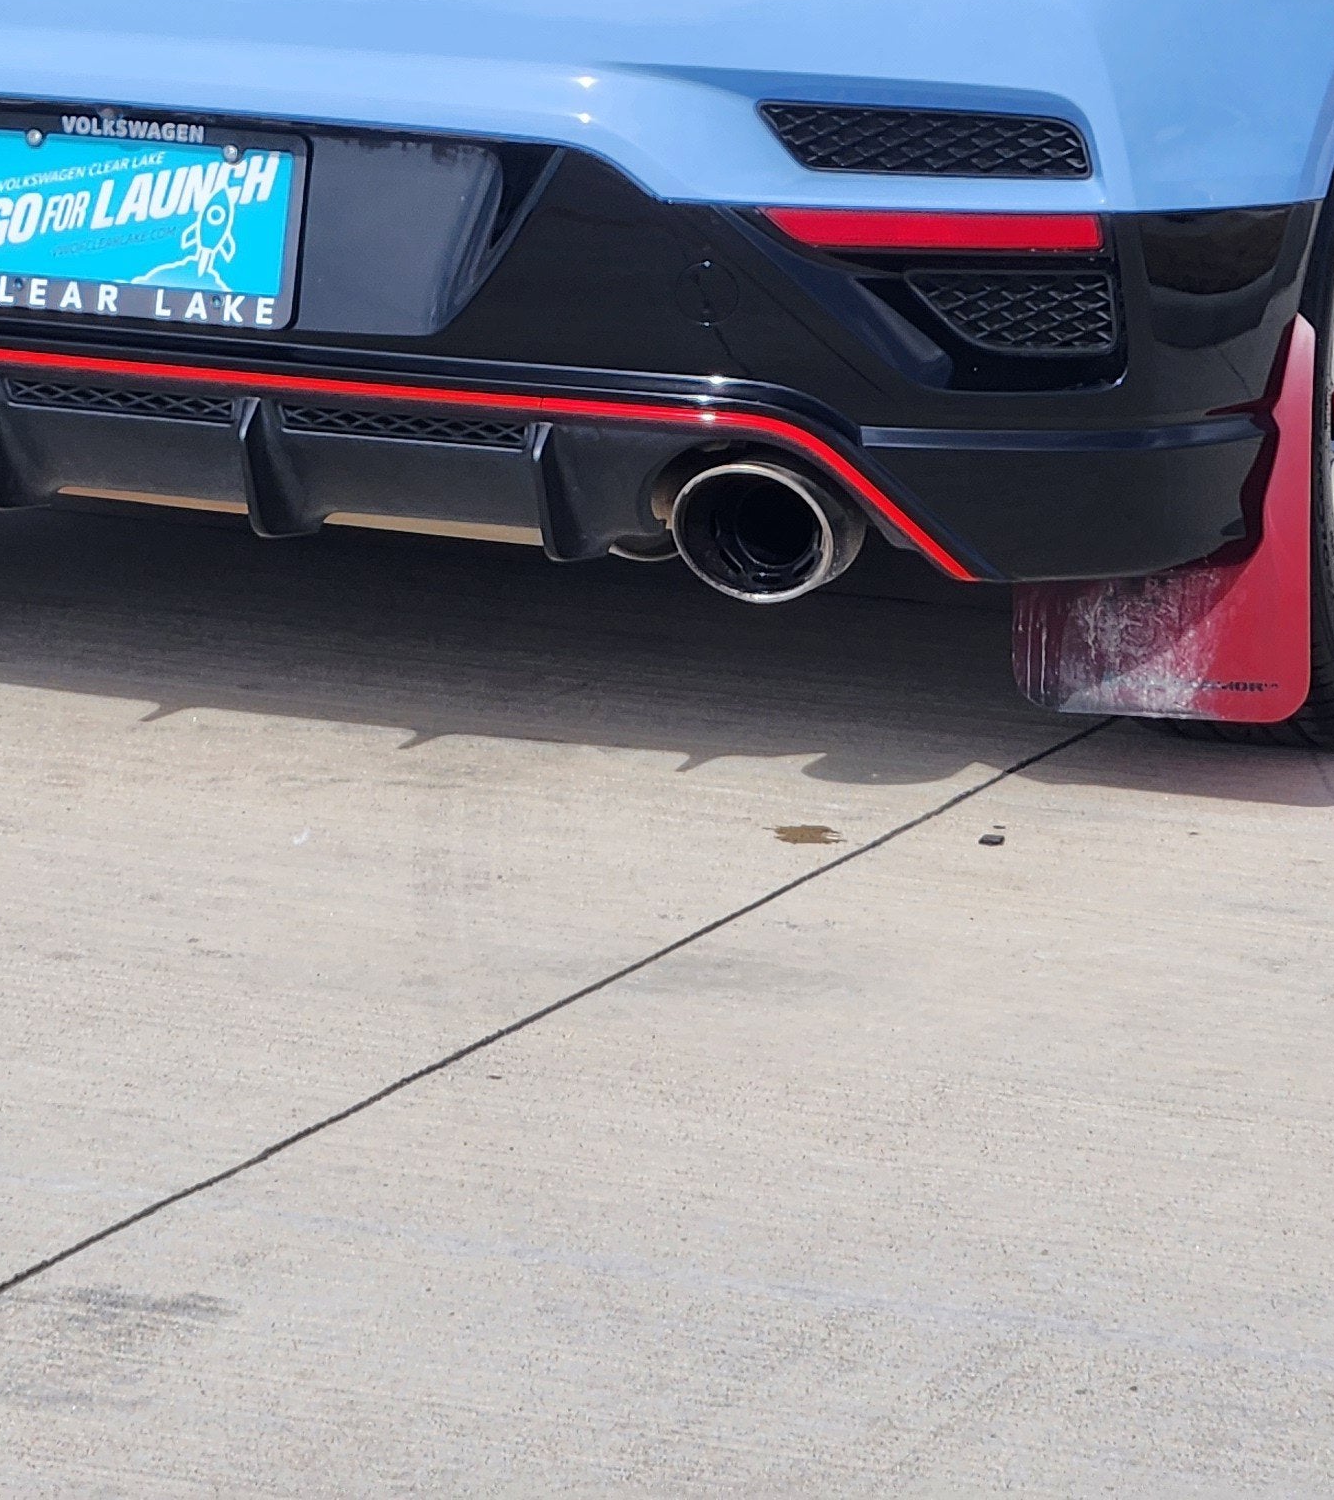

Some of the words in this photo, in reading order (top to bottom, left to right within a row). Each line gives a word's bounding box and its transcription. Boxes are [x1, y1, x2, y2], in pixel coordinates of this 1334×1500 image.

[62, 115, 205, 143] VOLKSWAGEN
[88, 156, 130, 177] CLEAR
[131, 151, 167, 166] LAKE
[40, 190, 91, 235] FOR
[90, 151, 281, 230] LAUNCH
[154, 289, 276, 326] LAKE
